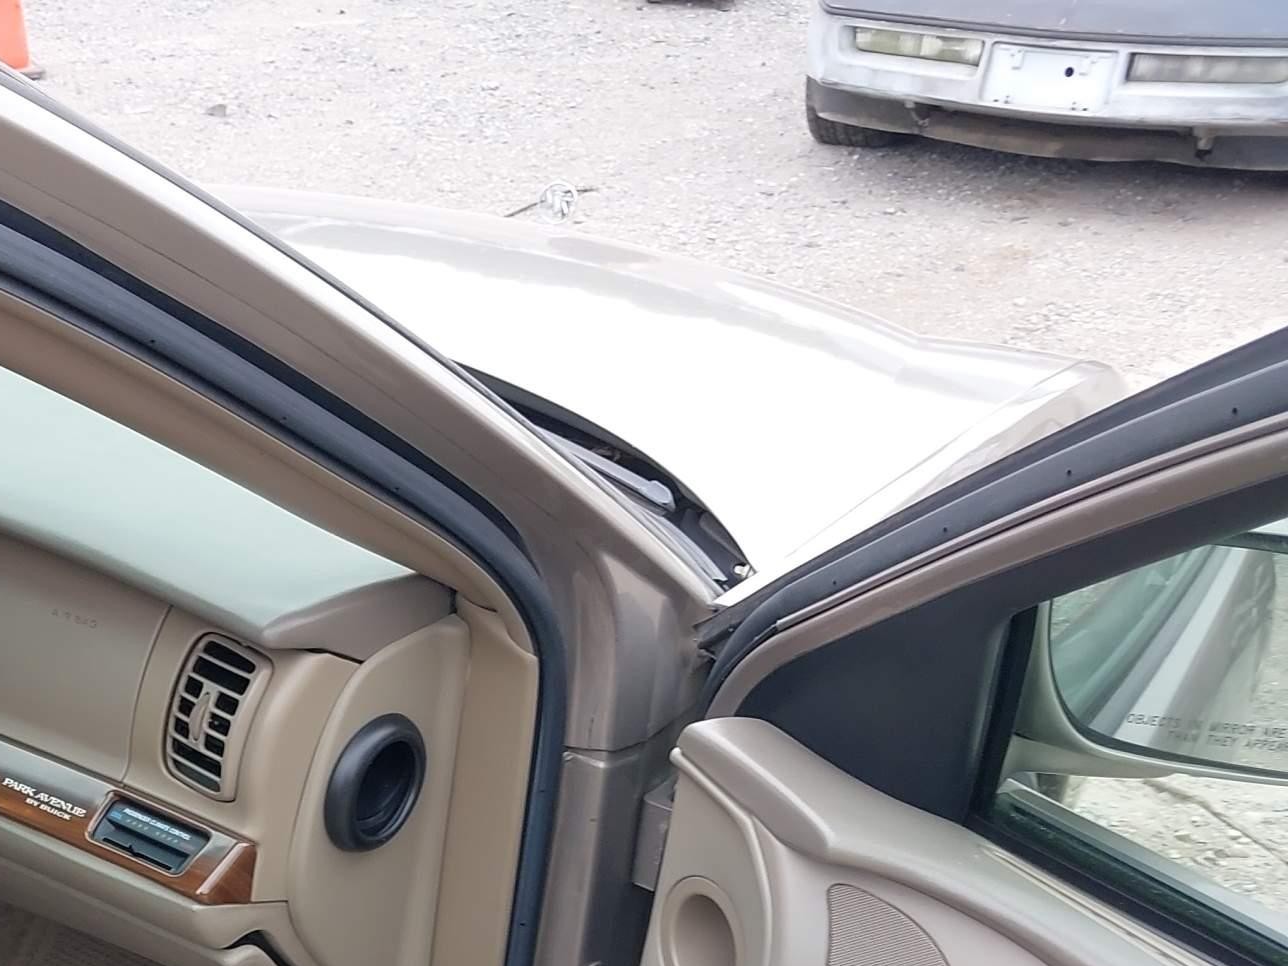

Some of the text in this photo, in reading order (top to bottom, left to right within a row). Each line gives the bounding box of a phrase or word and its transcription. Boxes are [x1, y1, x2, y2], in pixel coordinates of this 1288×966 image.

[1126, 713, 1181, 728] OBJECTS
[1, 777, 37, 796] PARK
[35, 793, 87, 817] AVENUE
[24, 797, 73, 821] BY BUICK
